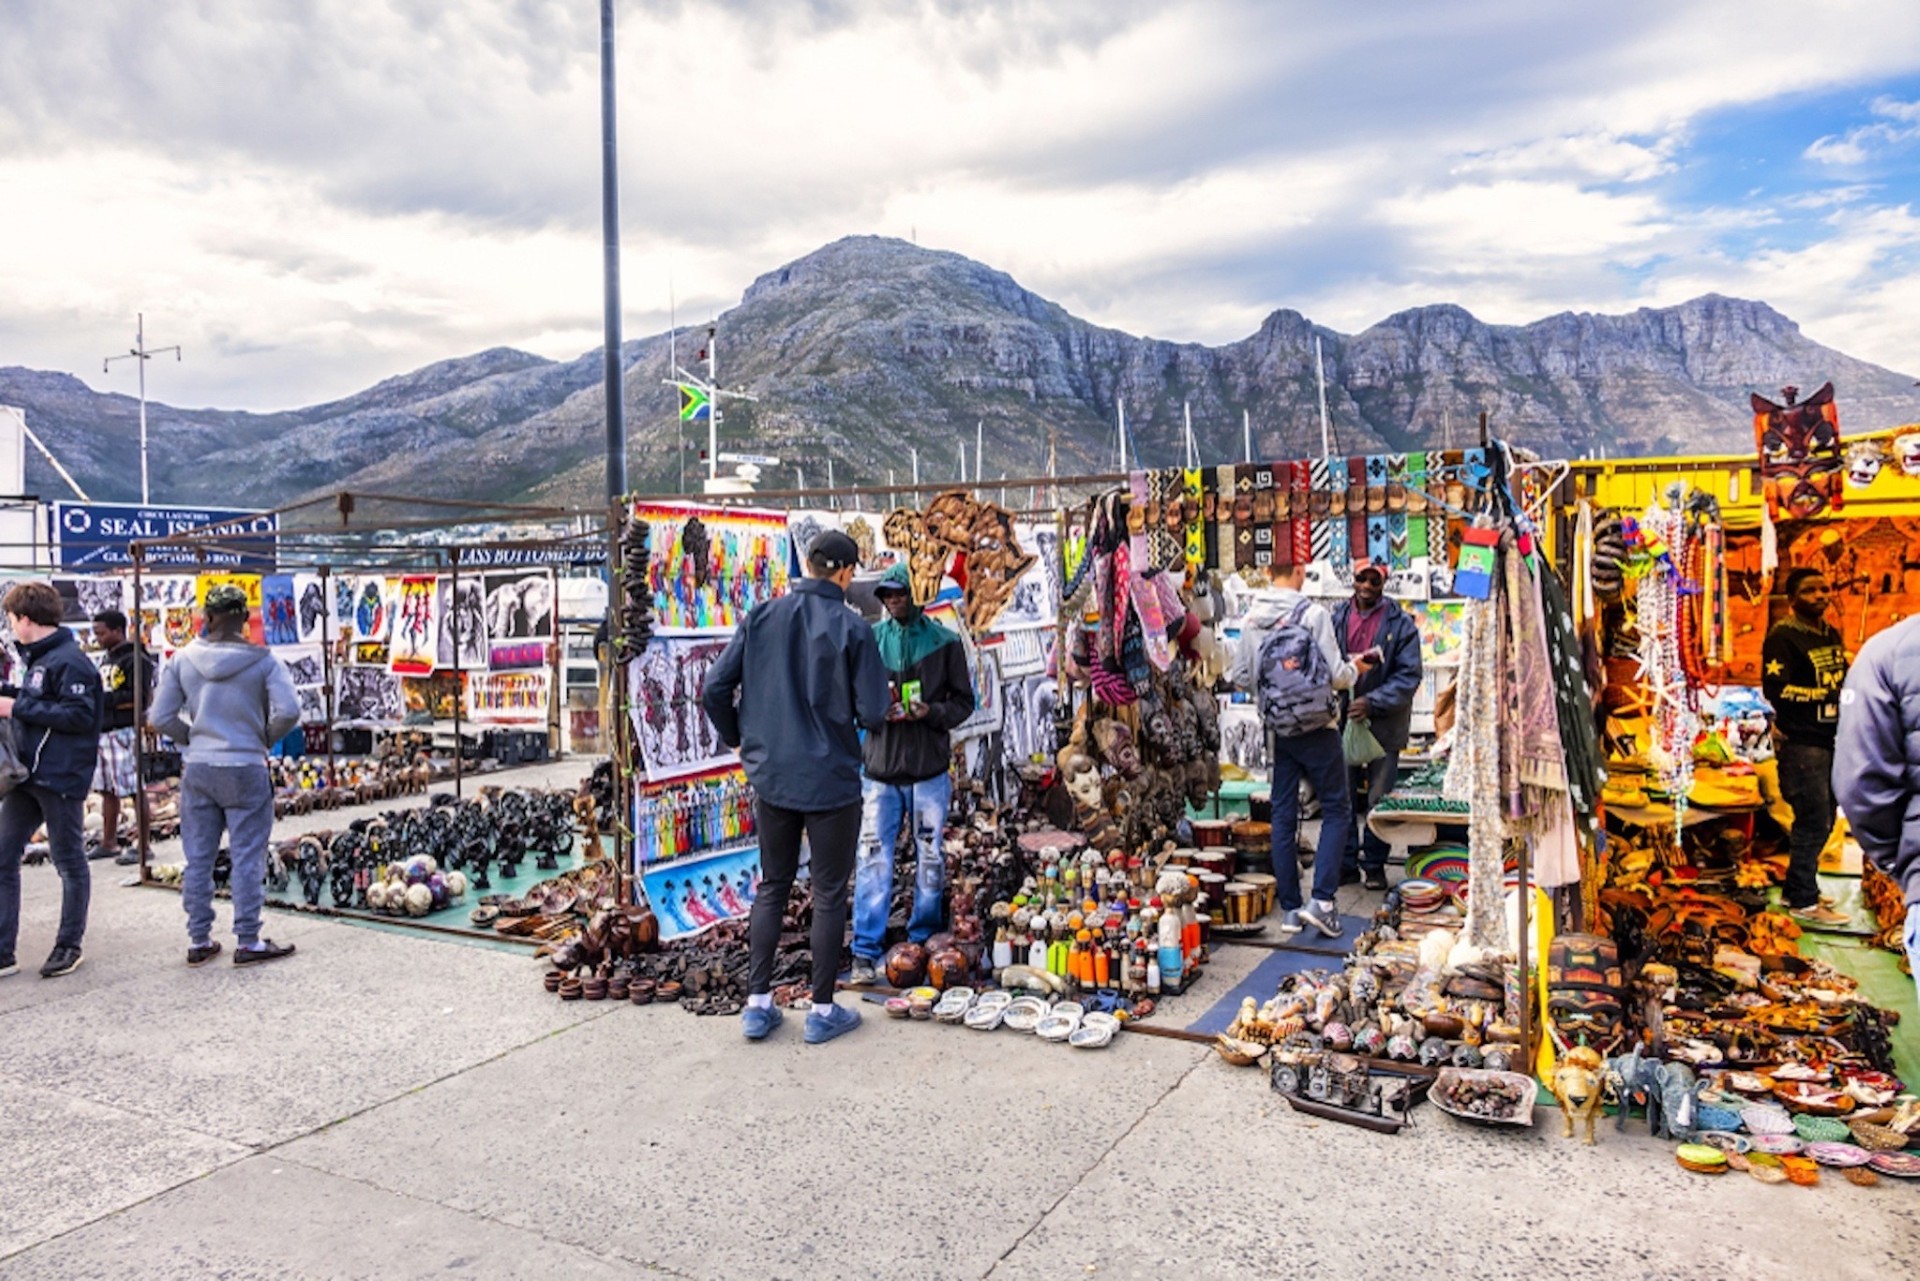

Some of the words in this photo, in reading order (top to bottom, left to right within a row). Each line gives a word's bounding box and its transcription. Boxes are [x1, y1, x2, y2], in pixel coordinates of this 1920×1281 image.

[100, 518, 158, 535] SEAL
[167, 520, 244, 537] ISLAND
[102, 552, 142, 562] GLA
[144, 552, 212, 563] BOTTOMD
[447, 547, 490, 565] LASS
[584, 548, 608, 561] BO
